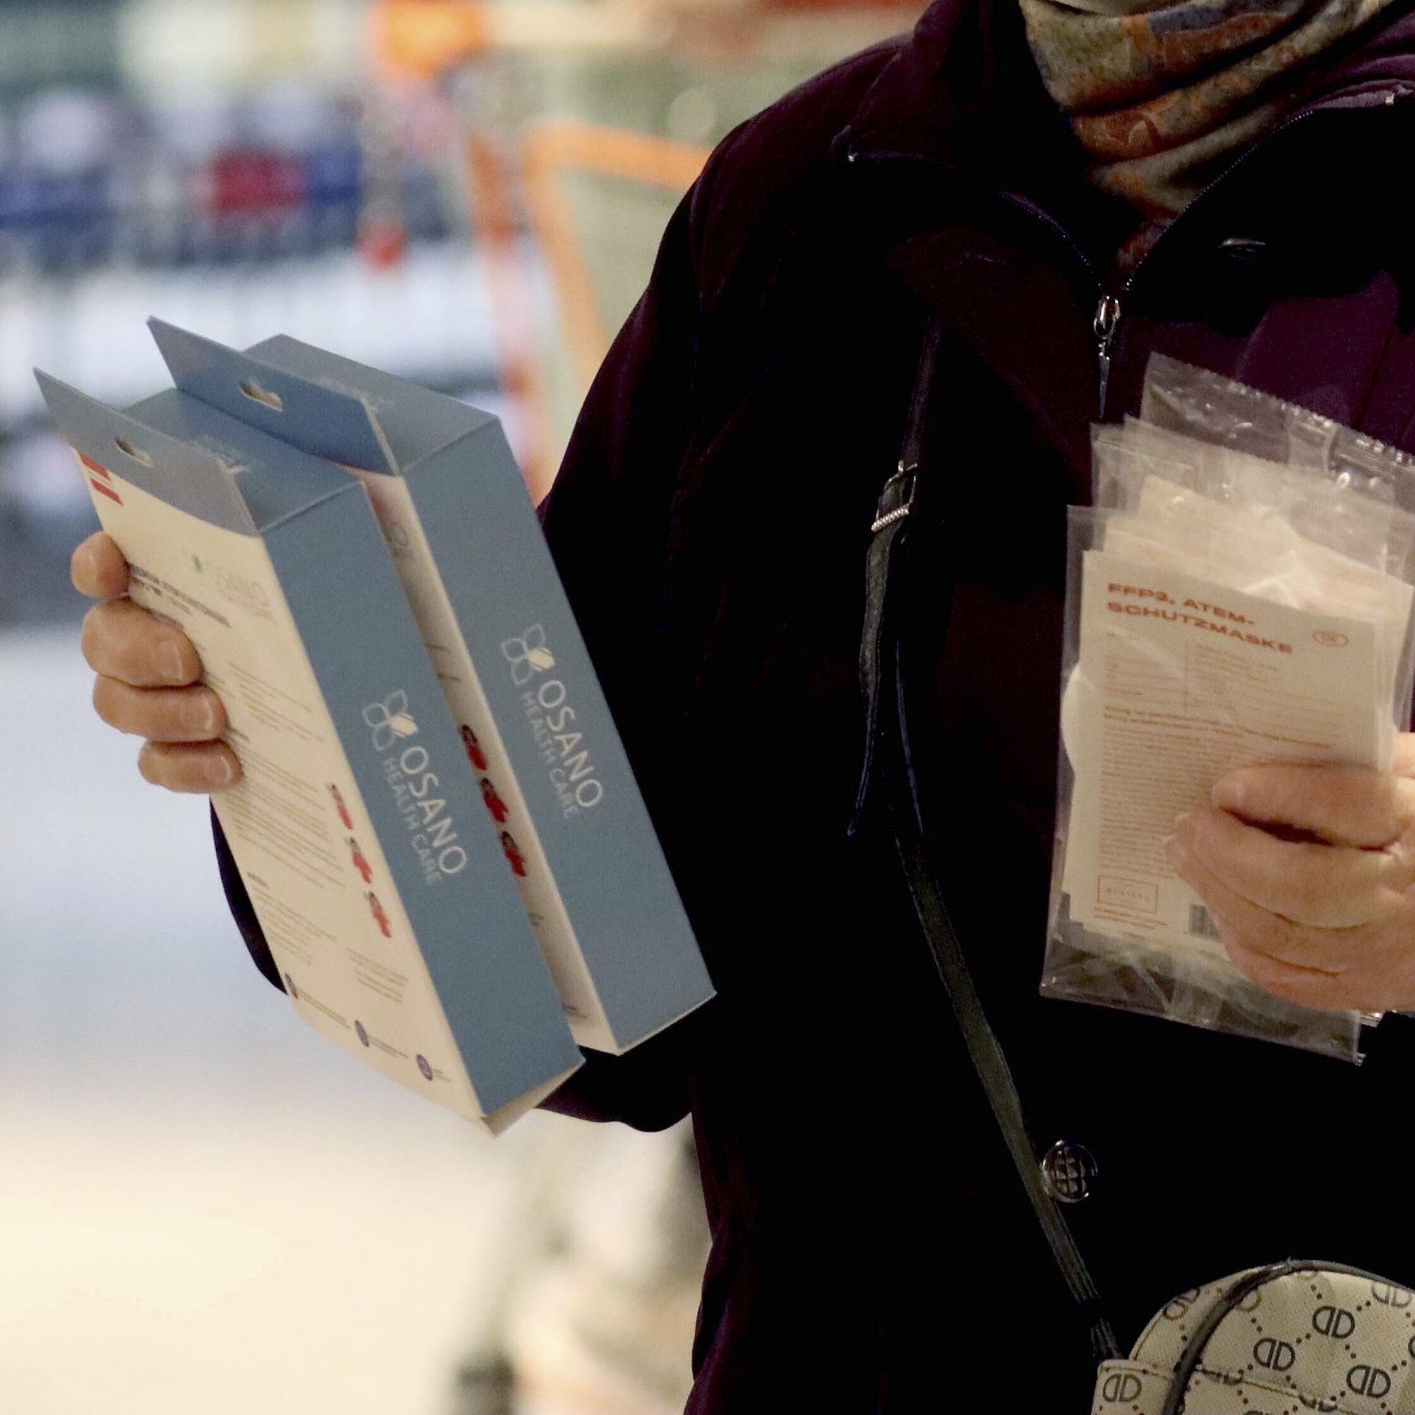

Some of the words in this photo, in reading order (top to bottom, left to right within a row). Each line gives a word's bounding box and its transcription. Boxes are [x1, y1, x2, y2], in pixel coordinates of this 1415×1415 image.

[1107, 601, 1293, 654] SCHUTZMASKE
[1183, 598, 1255, 626] ATEM-
[521, 691, 558, 765] HEALTH
[550, 768, 580, 819] CARE
[538, 680, 603, 807] OSANO
[383, 757, 421, 831] HEALTH
[411, 834, 443, 884] CARE
[400, 746, 467, 874] OSANO
